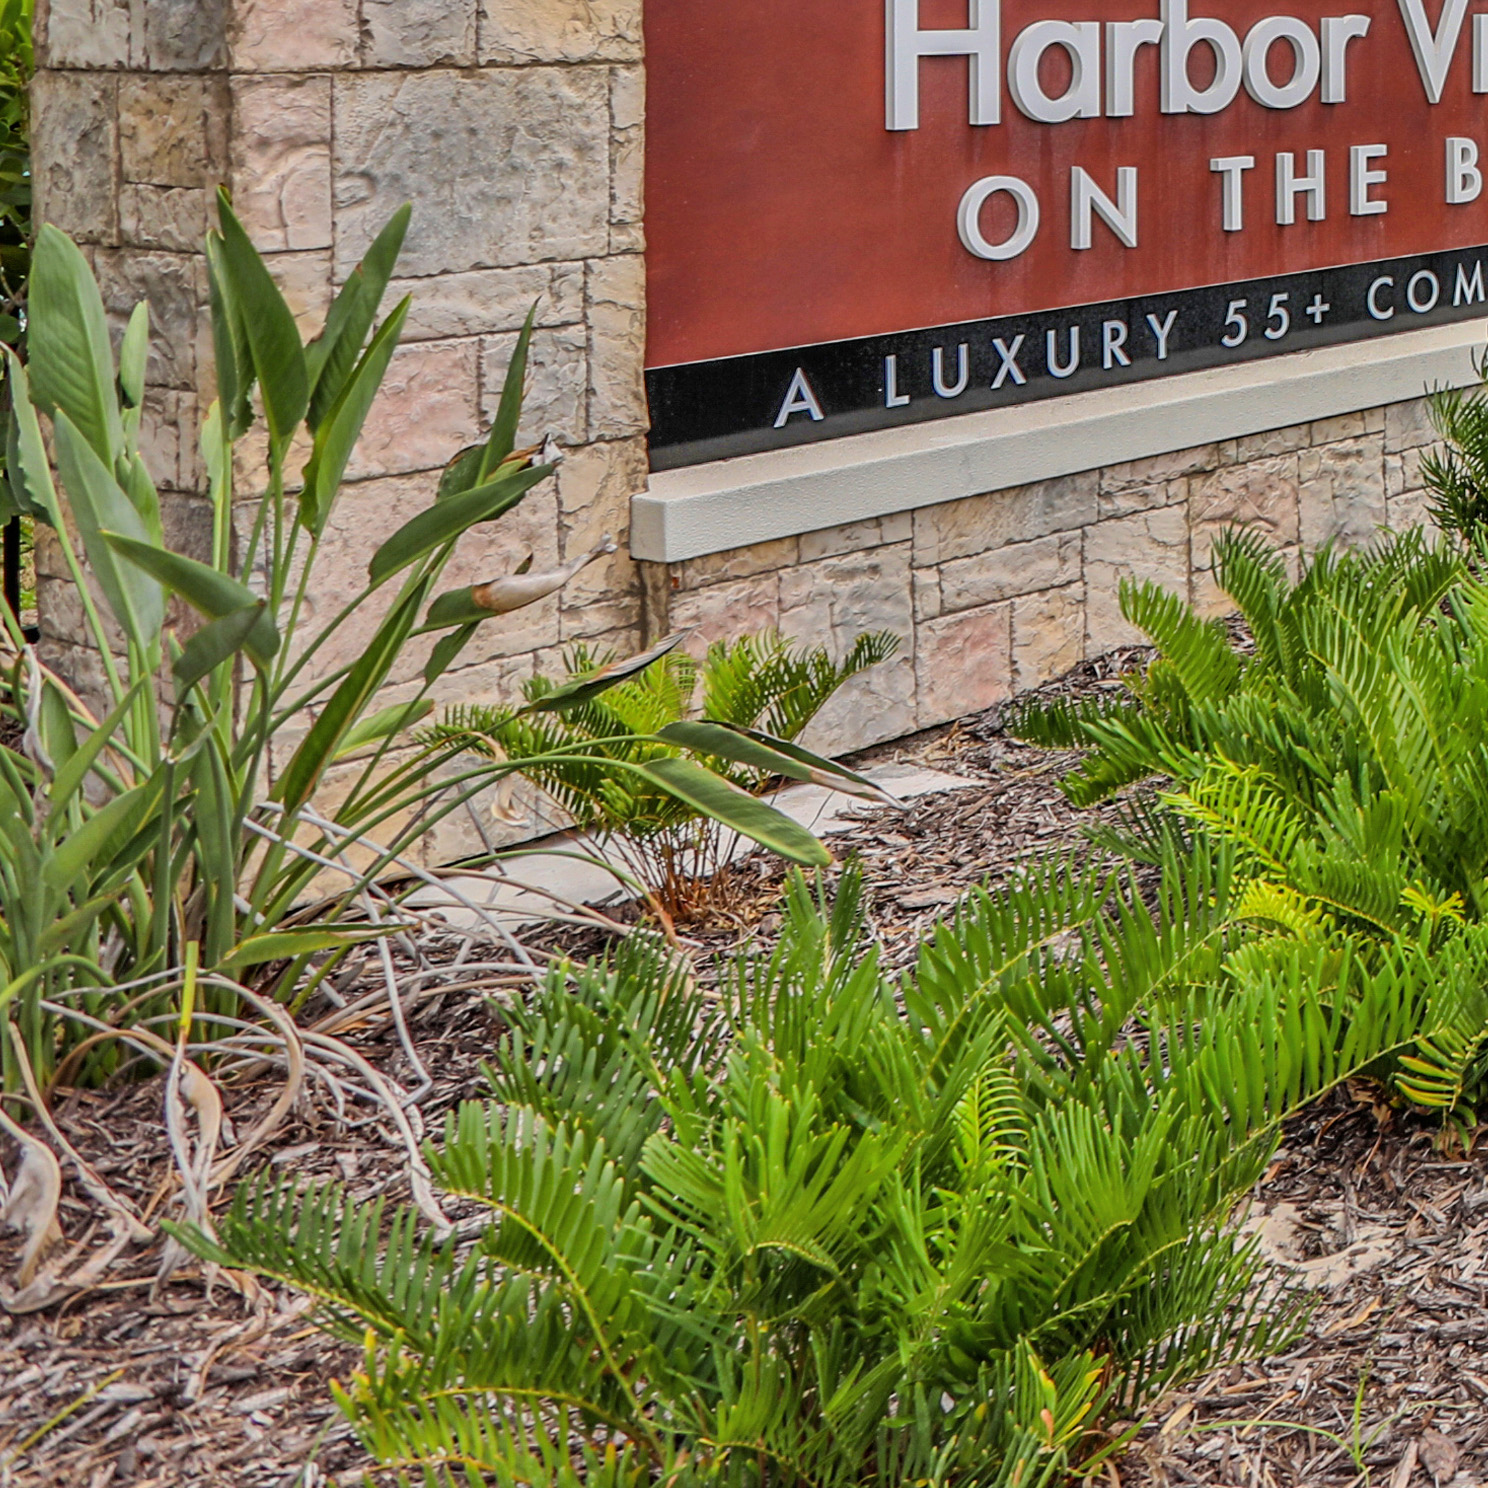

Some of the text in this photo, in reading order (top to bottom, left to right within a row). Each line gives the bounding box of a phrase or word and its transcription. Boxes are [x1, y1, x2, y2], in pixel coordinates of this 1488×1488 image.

[957, 166, 1139, 261] ON
[1210, 143, 1389, 233] THE
[773, 367, 825, 430] A
[883, 310, 1178, 409] LUXURY
[1222, 293, 1331, 348] 55+
